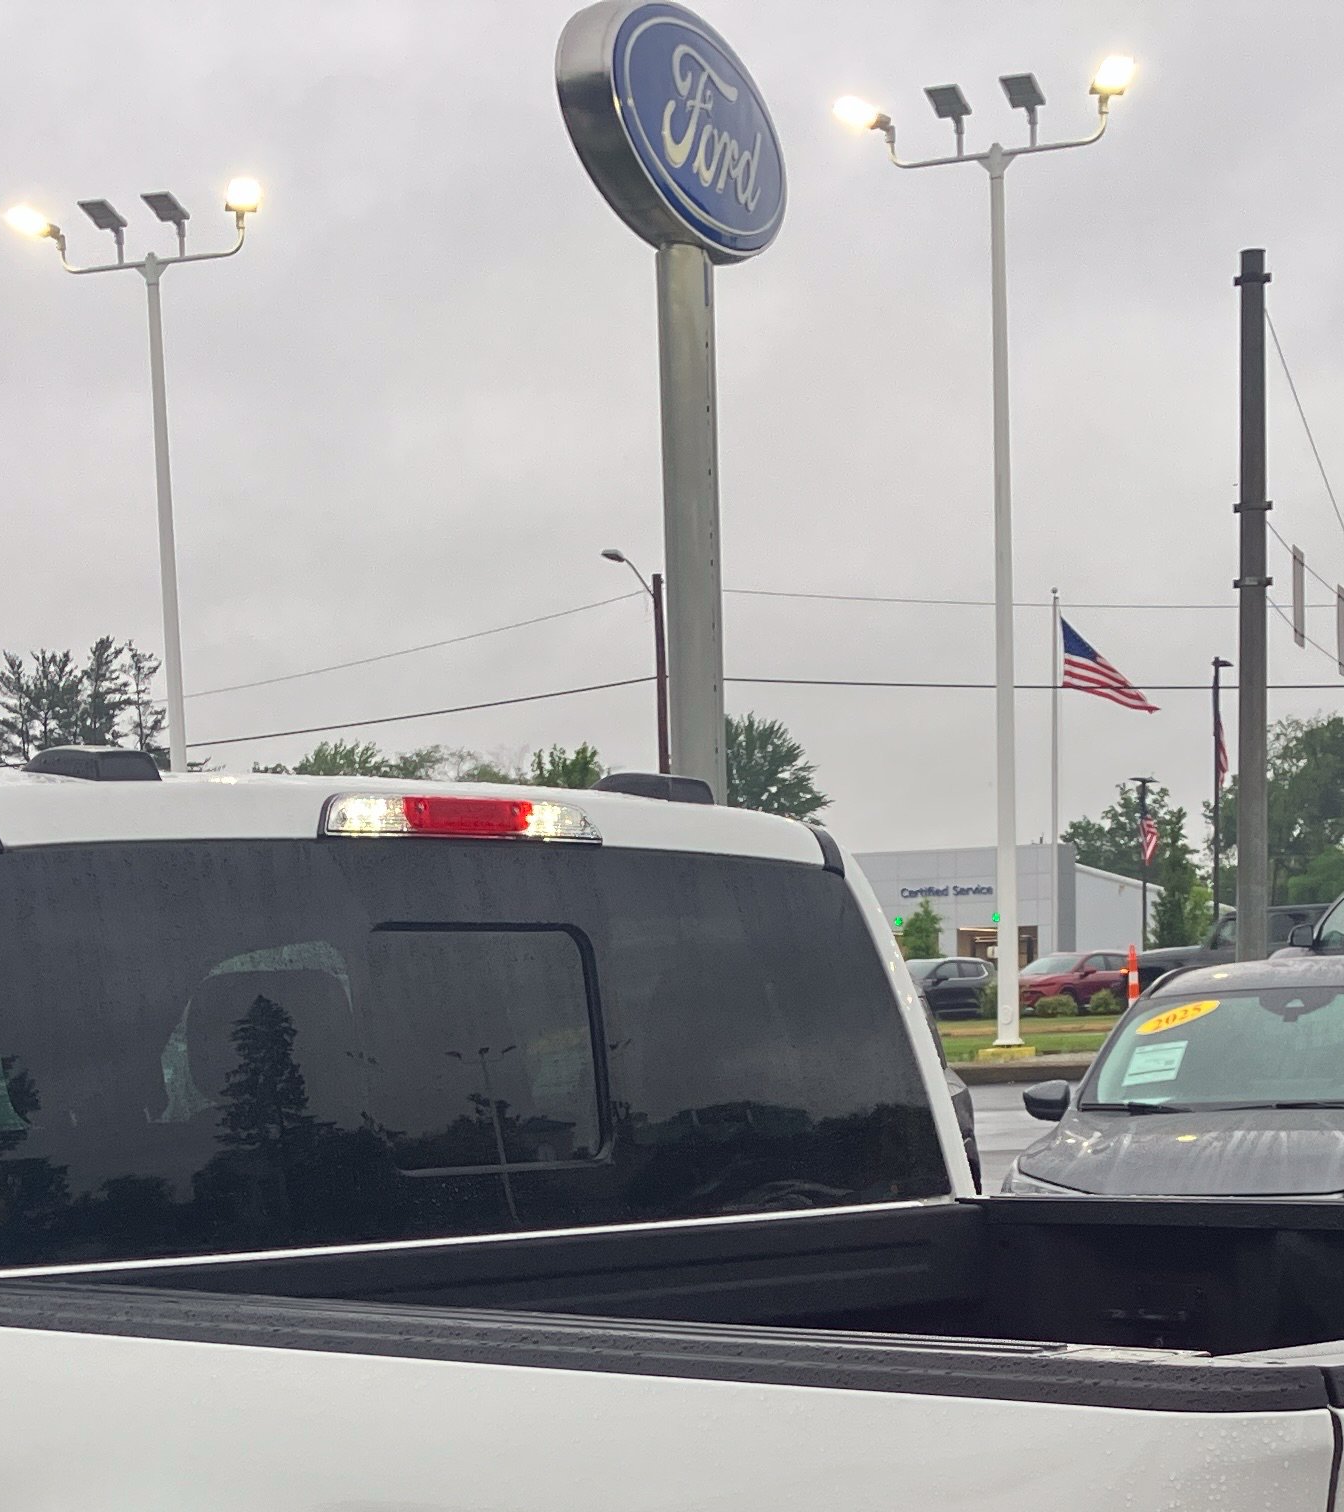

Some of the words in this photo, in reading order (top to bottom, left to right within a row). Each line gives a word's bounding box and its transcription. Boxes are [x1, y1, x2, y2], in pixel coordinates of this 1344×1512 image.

[662, 44, 763, 213] Ford
[900, 885, 949, 898] Certified
[952, 884, 994, 896] Service
